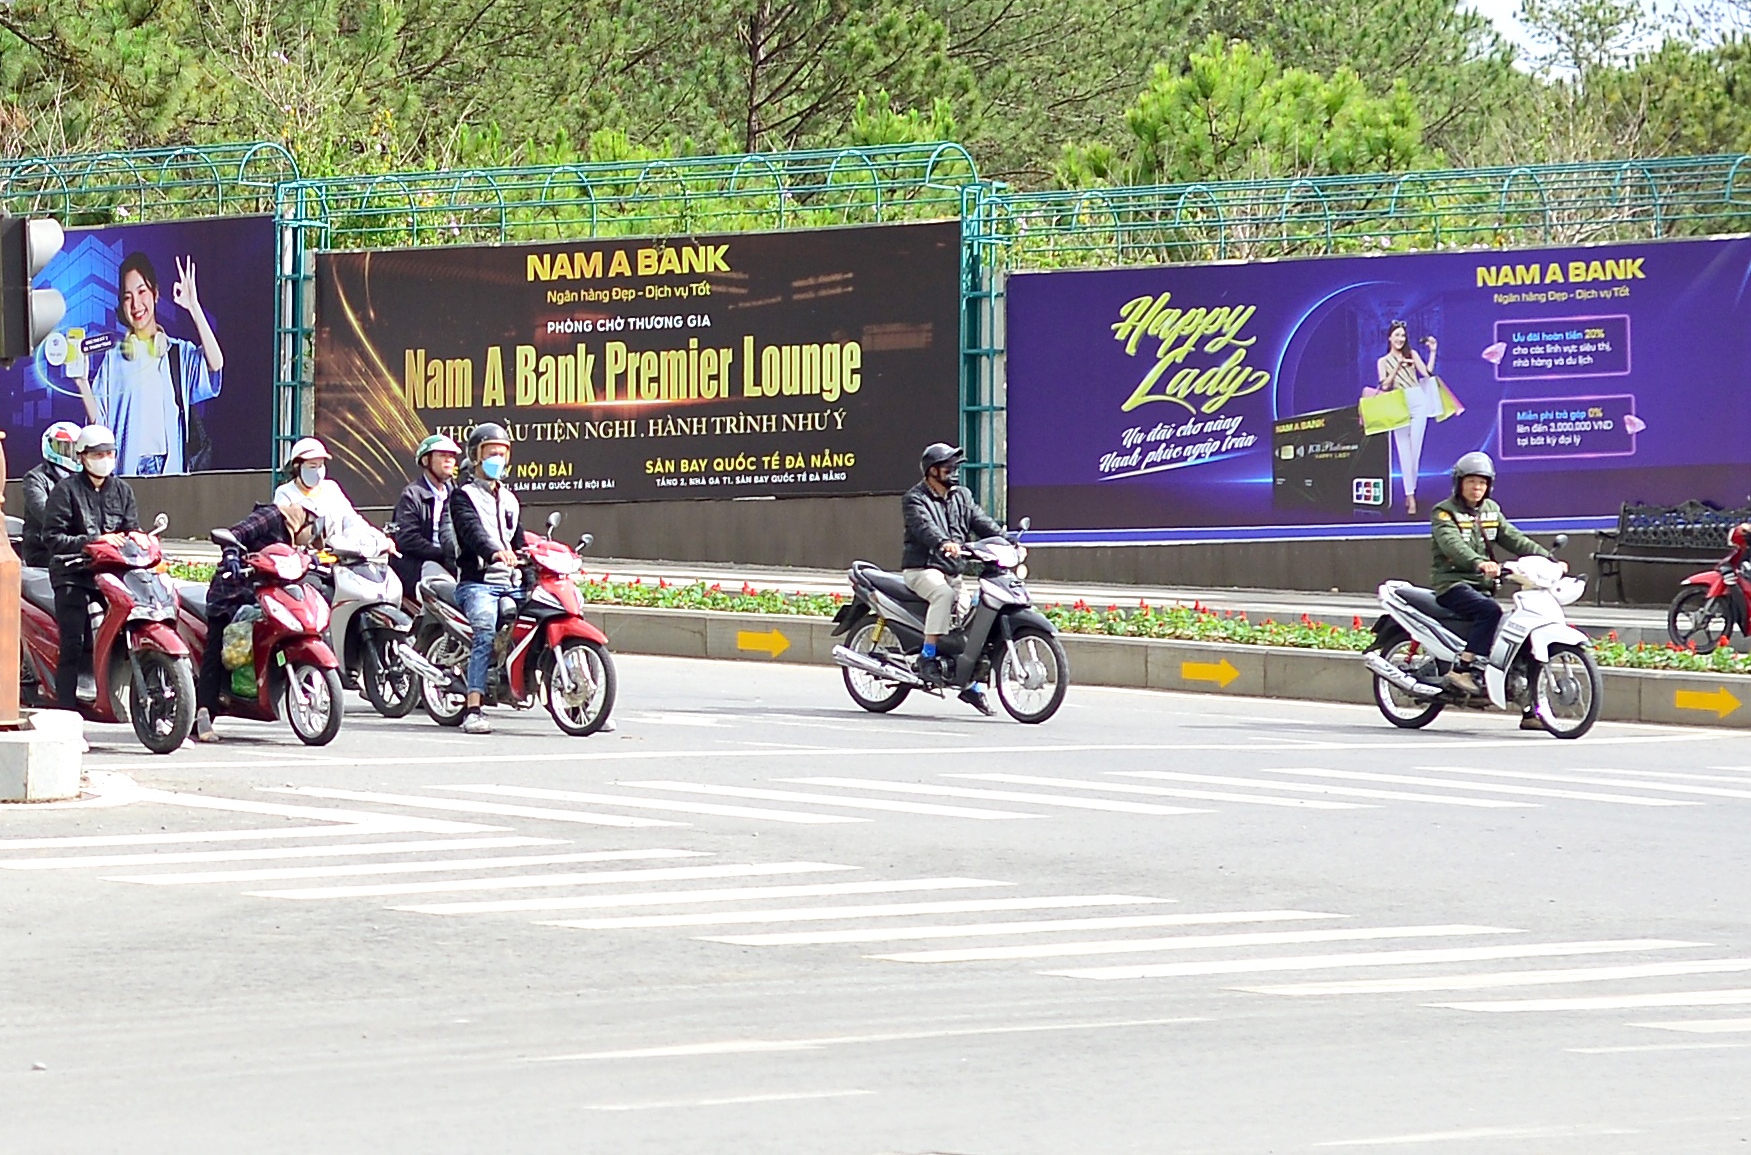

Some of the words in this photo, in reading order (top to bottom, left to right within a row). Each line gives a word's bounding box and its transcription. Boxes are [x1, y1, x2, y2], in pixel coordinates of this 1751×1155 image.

[526, 251, 602, 282] NAM
[608, 250, 632, 277] A
[637, 244, 731, 276] BANK
[1476, 263, 1540, 288] NAM
[1544, 262, 1564, 284] A
[1568, 257, 1646, 283] BANK
[547, 289, 578, 305] Ngân
[580, 287, 609, 303] hàng
[612, 287, 636, 302] Đẹp
[645, 284, 671, 301] Dịch
[674, 286, 688, 300] vụ
[689, 279, 711, 296] Tốt
[547, 317, 592, 334] PHÒNG
[597, 315, 625, 332] CHỜ
[628, 314, 683, 330] THƯƠNG
[686, 313, 711, 329] GIA
[1111, 291, 1257, 363] Happy
[405, 348, 472, 409] Nam
[482, 345, 506, 407] A
[515, 342, 596, 407] Bank
[605, 337, 733, 402] Premier
[743, 335, 862, 403] Lounge
[1121, 348, 1271, 415] Lady
[532, 418, 579, 445] TIỆN
[584, 419, 637, 441] NGHI
[648, 414, 707, 437] HÀNH
[711, 411, 777, 435] TRÌNH
[782, 409, 831, 432] NHƯ
[833, 407, 847, 431] Ý
[516, 460, 544, 480] NỘI
[548, 459, 573, 477] BÀI
[645, 456, 675, 474] SÂN
[680, 458, 708, 473] BAY
[713, 451, 757, 472] QUỐC
[761, 450, 780, 470] TẾ
[785, 451, 805, 470] ĐÀ
[810, 448, 856, 468] NẴNG
[1099, 446, 1143, 473] Hạnh
[1141, 442, 1183, 470] phúc
